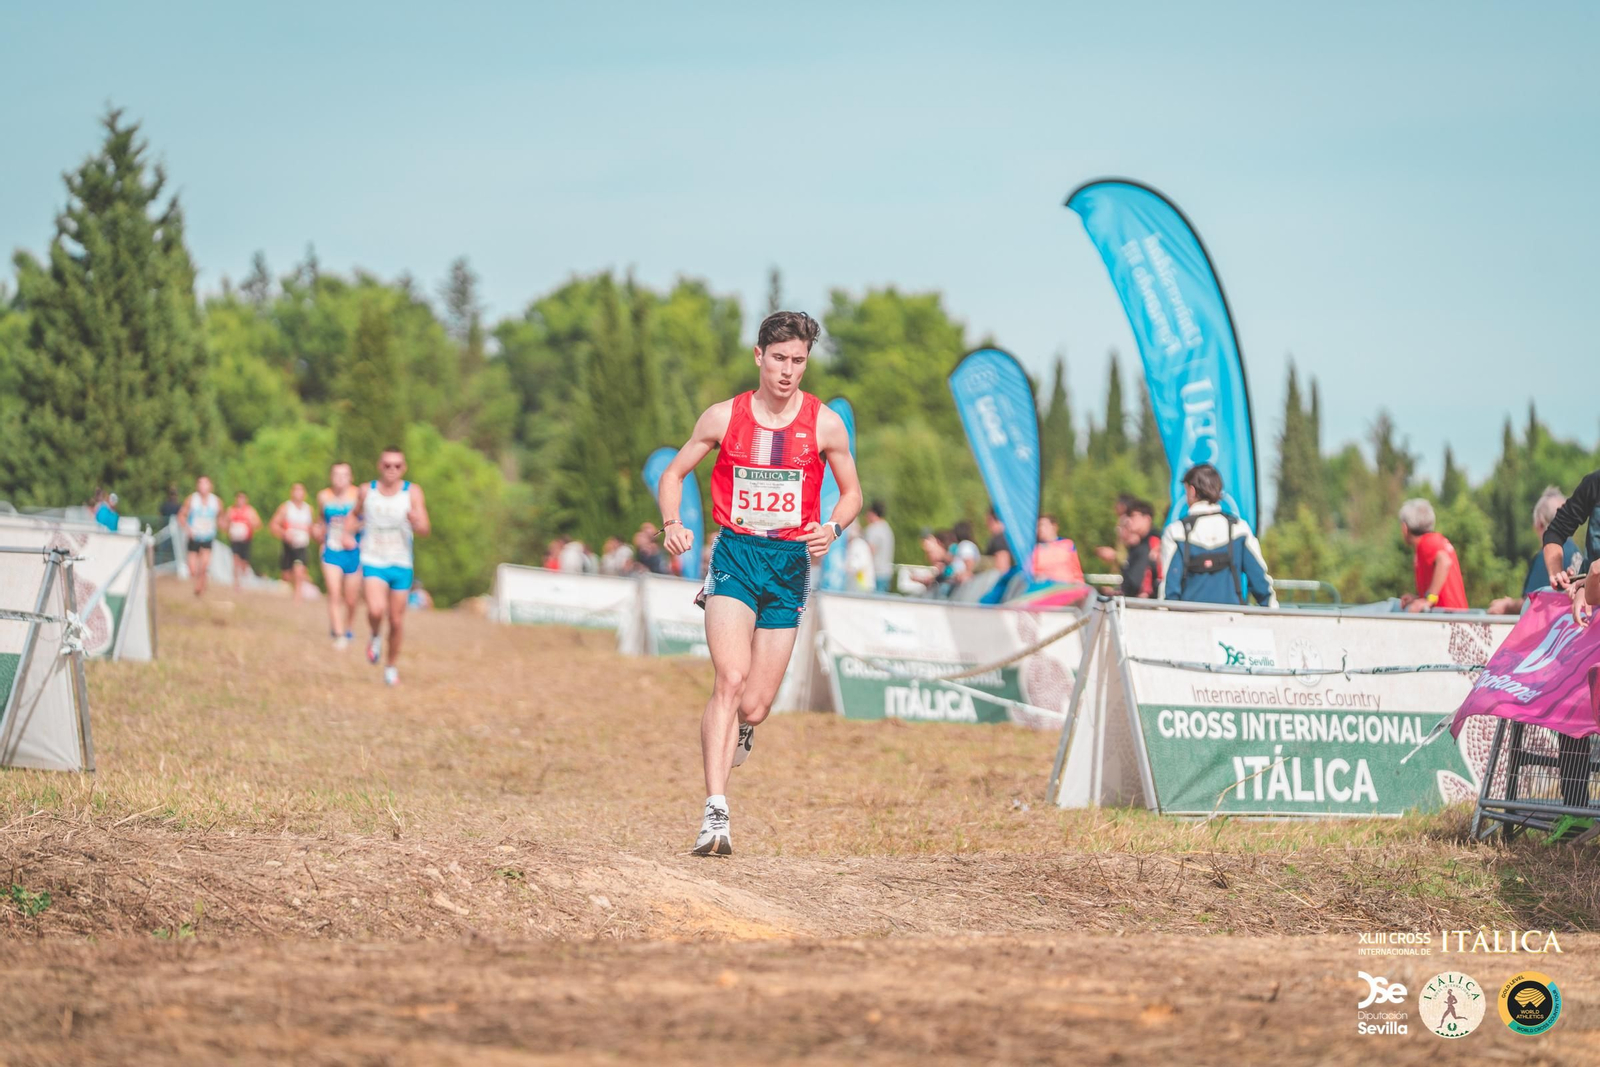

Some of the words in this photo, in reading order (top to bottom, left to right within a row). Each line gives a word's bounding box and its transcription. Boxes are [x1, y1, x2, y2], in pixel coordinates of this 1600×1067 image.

[751, 470, 784, 481] ITÁLICA
[738, 489, 796, 513] 5128
[1248, 656, 1276, 668] Sevilla
[884, 679, 979, 723] ITÁLICA
[1191, 683, 1282, 705] International
[1284, 687, 1322, 707] Cross
[1325, 688, 1381, 712] Country
[1157, 709, 1238, 741] CROSS
[1241, 711, 1427, 746] INTERNACIONAL
[1232, 744, 1379, 804] ITÁLICA
